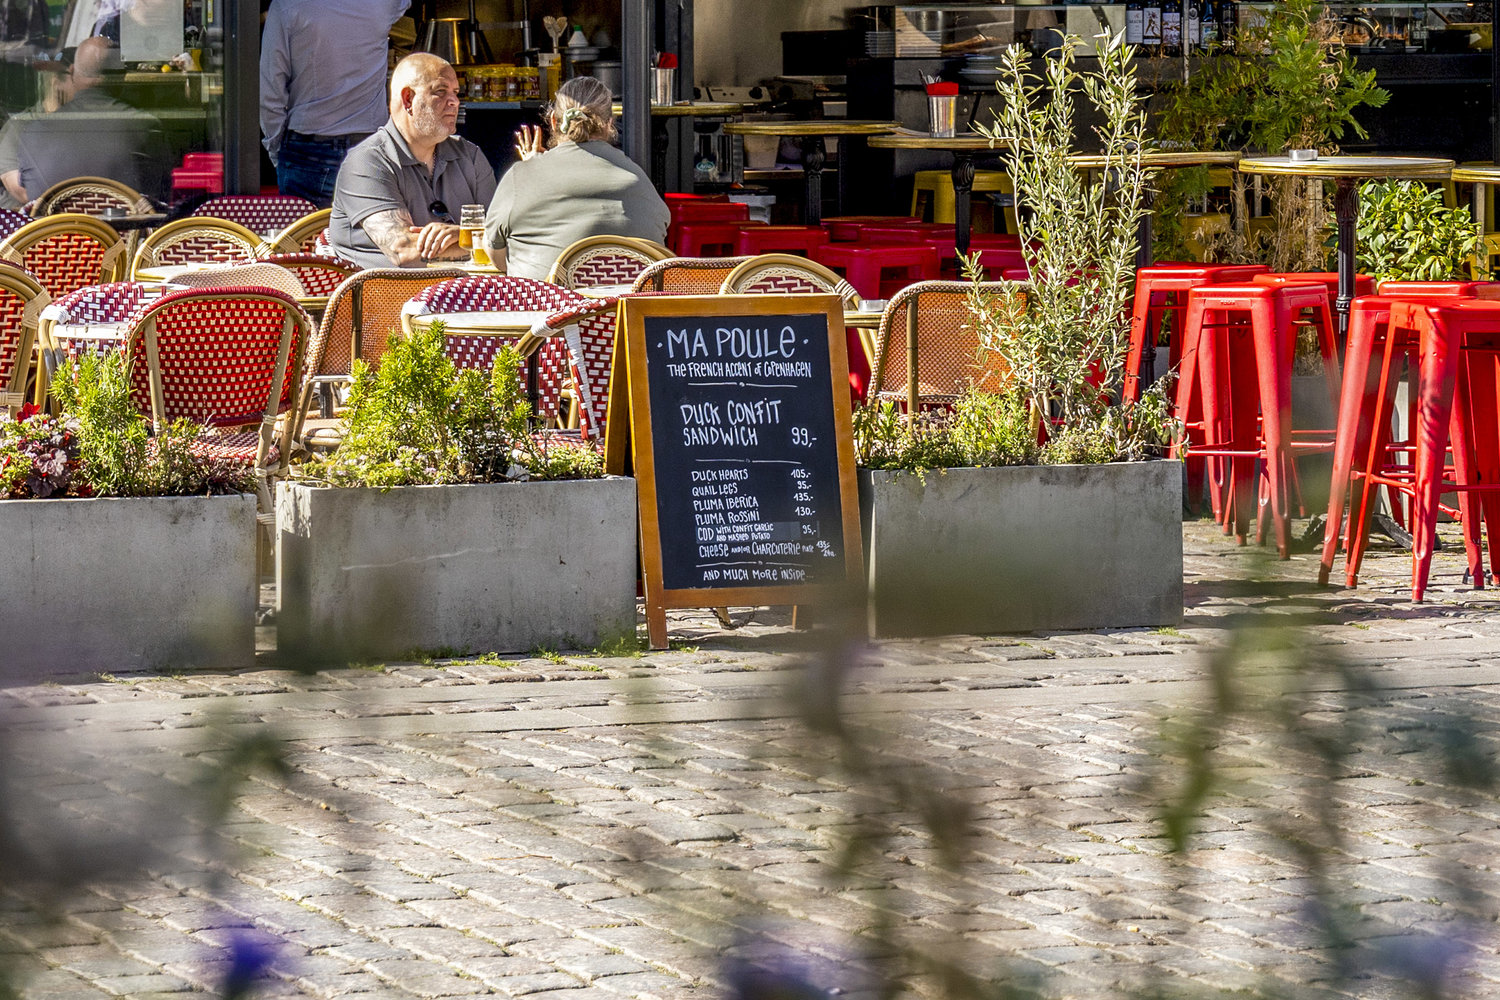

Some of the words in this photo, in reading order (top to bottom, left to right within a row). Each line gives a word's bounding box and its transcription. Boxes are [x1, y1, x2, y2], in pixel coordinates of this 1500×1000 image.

[666, 327, 709, 359] MA
[680, 402, 722, 426] DUCK
[691, 470, 717, 482] DUCK
[693, 498, 725, 511] PLUMA
[695, 512, 725, 526] PLUMA
[697, 527, 714, 541] COD
[703, 569, 720, 581] AND
[723, 569, 749, 581] MUCH
